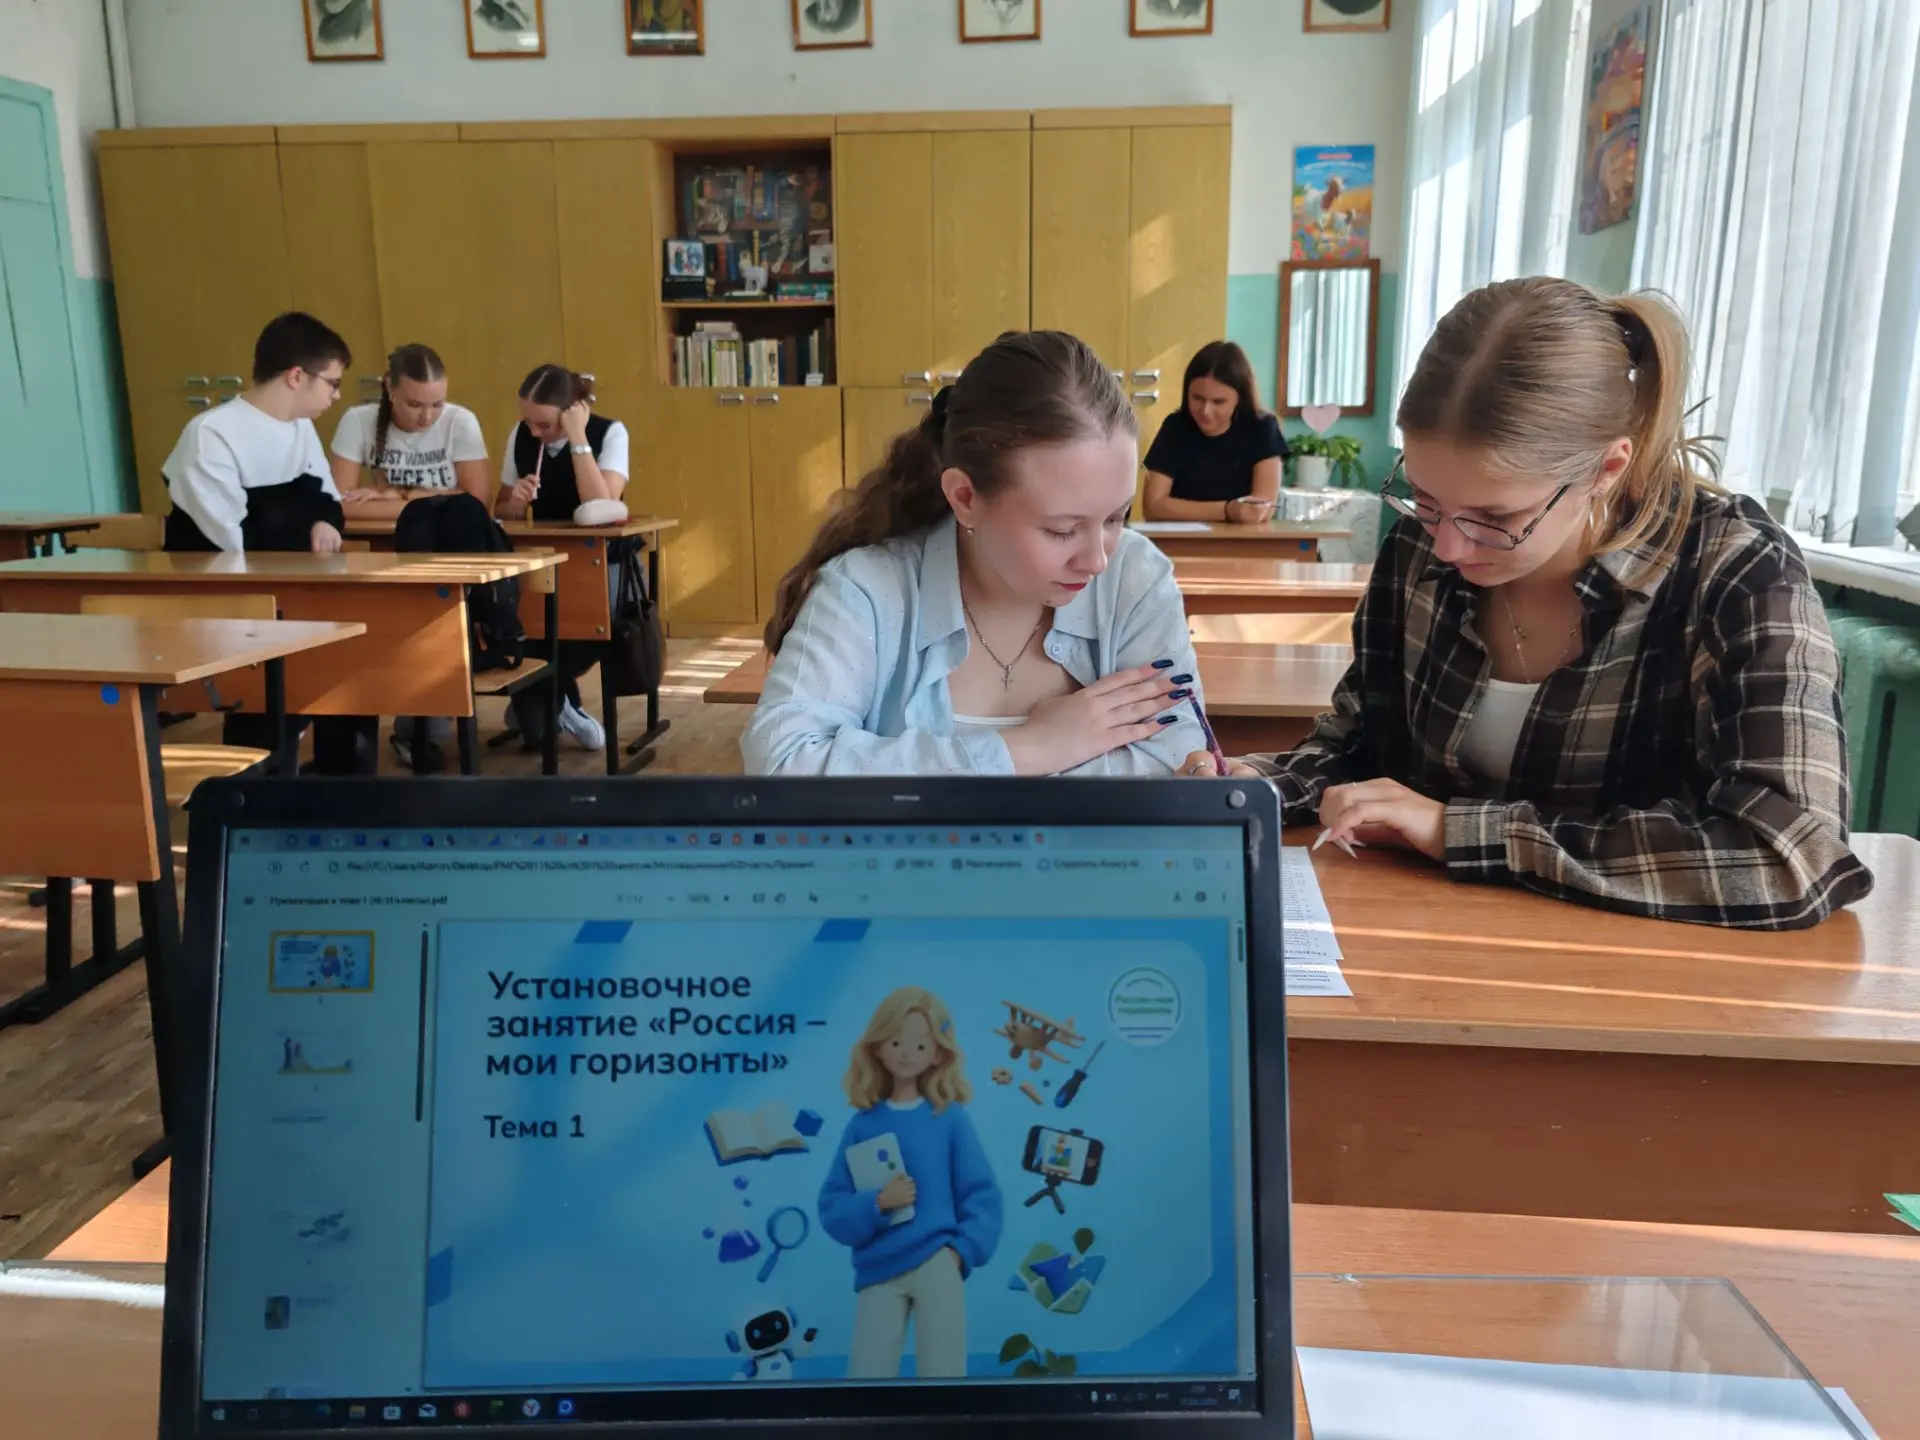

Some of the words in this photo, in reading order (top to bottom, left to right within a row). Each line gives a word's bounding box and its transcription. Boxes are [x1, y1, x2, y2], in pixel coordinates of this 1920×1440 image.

[487, 970, 752, 1001] Установочное
[486, 1014, 638, 1039] занятие
[648, 1007, 796, 1037] «Россия
[486, 1053, 557, 1077] мои
[570, 1051, 789, 1083] горизонты»
[483, 1114, 558, 1139] Тема
[569, 1113, 586, 1138] 1
